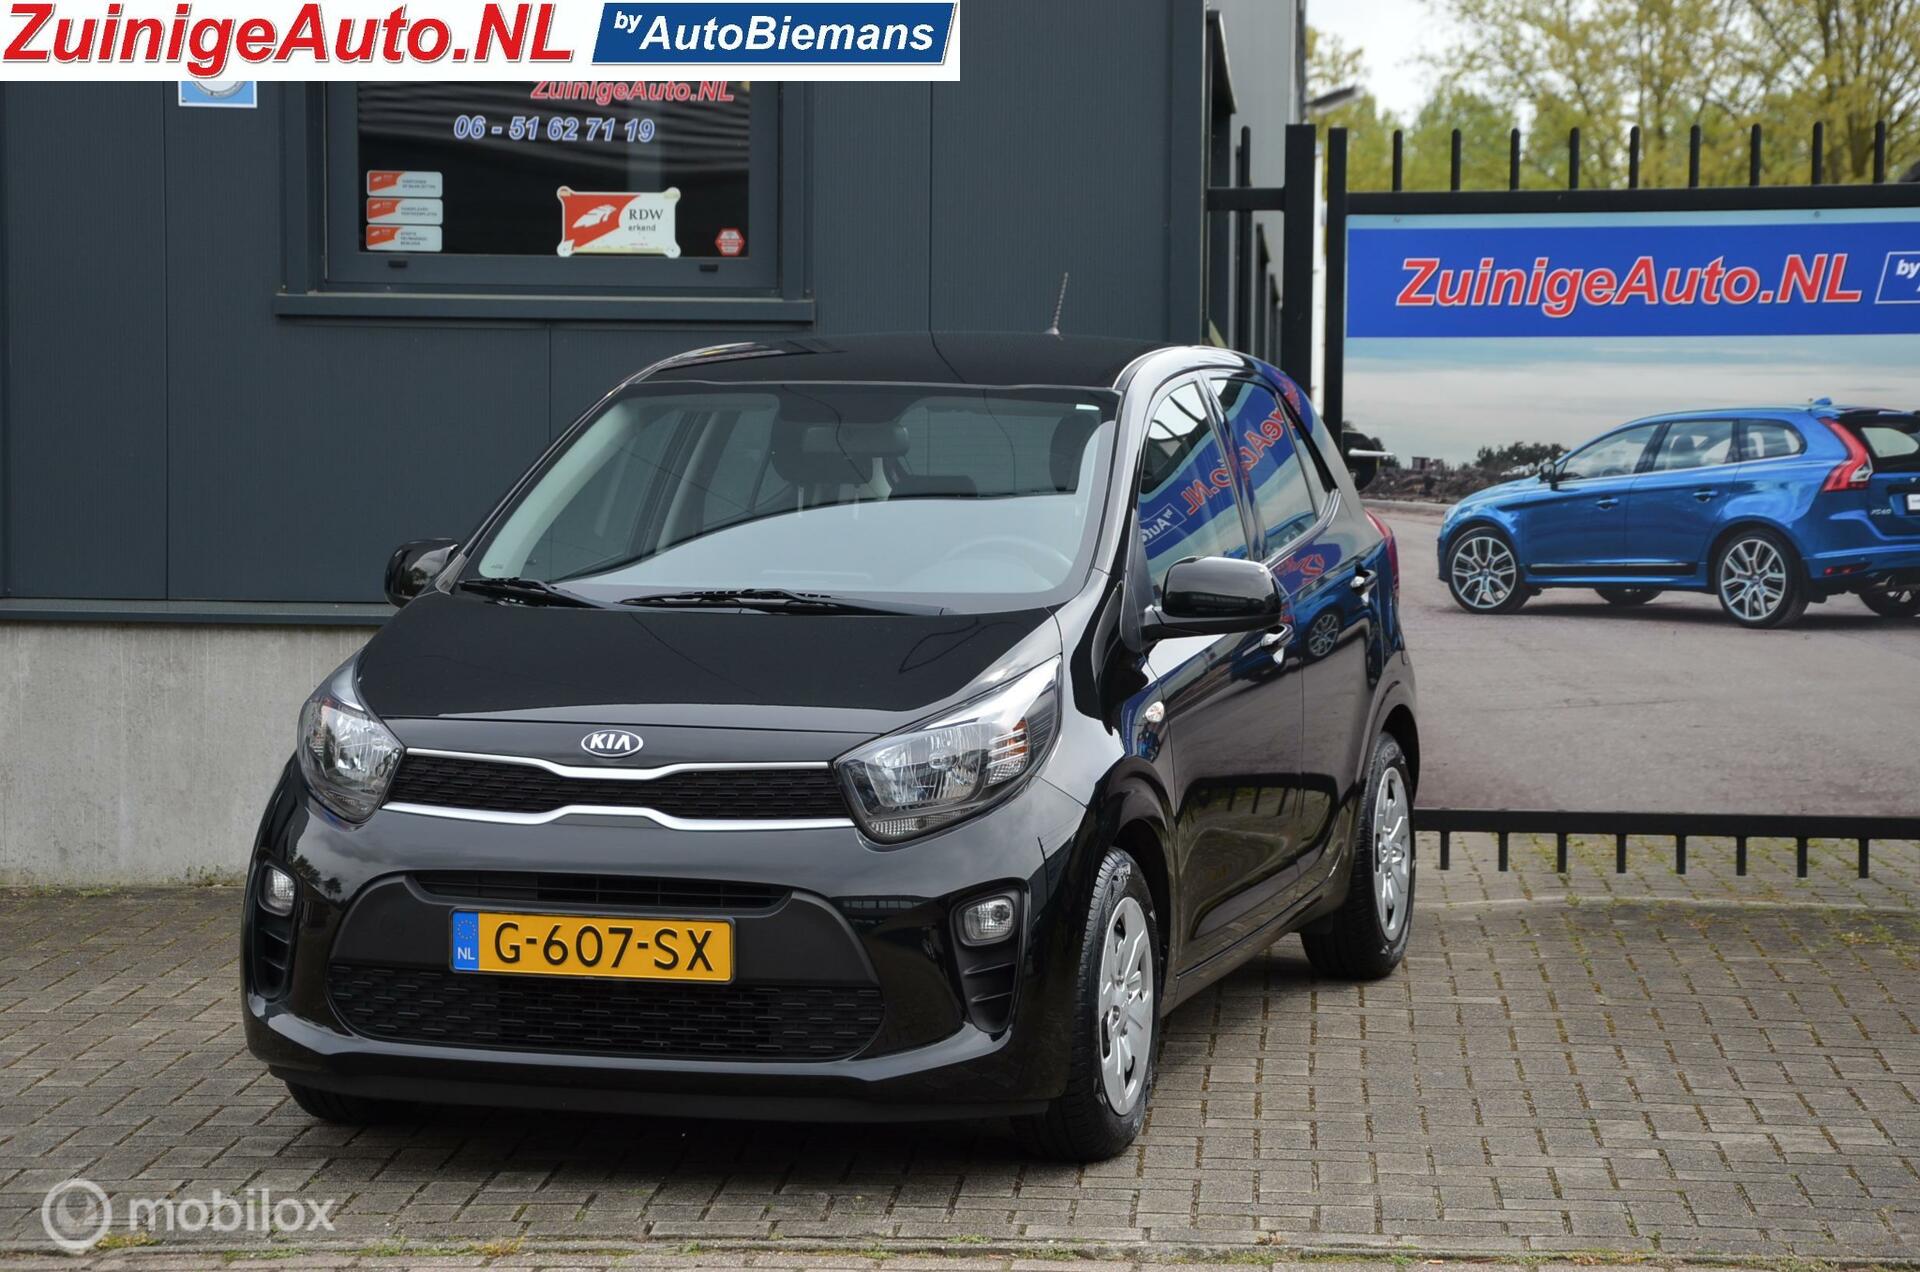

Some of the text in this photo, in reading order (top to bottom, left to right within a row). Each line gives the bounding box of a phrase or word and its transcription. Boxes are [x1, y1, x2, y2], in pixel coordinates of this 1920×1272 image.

[530, 81, 734, 105] ZuinigeAuto.NL
[453, 115, 655, 142] 06 - 51 62 71 19
[628, 208, 663, 221] RDW
[628, 223, 657, 232] erkend
[1896, 259, 1920, 279] by
[1396, 253, 1862, 318] ZuinigeAuto.NL
[590, 733, 631, 750] KIA
[457, 946, 476, 961] NL
[494, 922, 714, 972] G-607-SX
